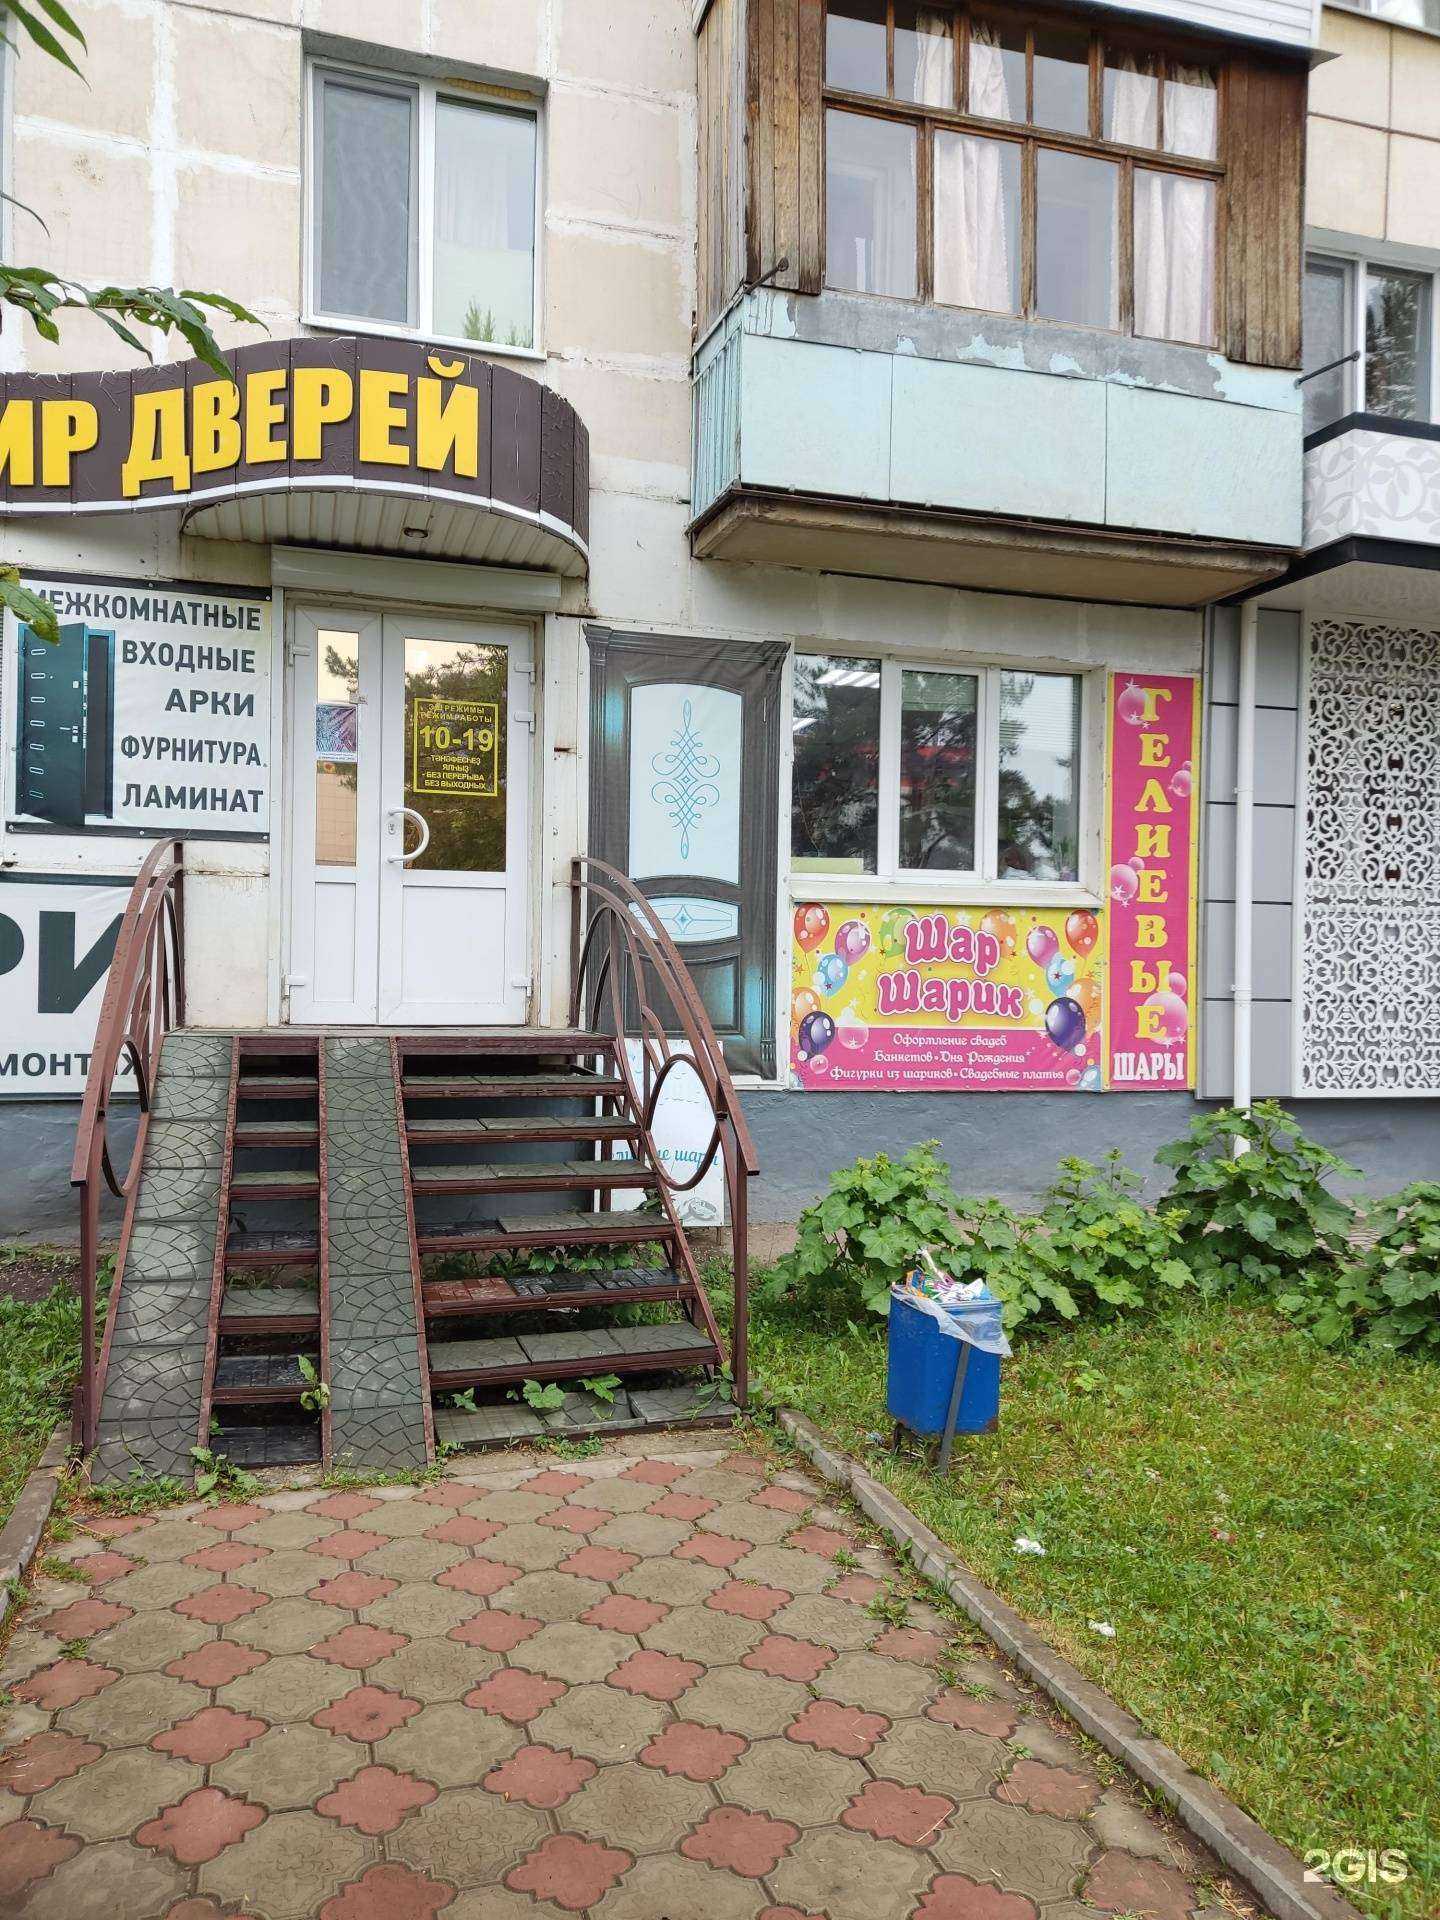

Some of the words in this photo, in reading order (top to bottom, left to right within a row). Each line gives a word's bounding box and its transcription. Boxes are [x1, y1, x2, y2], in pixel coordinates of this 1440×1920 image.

[122, 355, 480, 498] ДВЕРЕЙ
[28, 588, 261, 632] ЕЖКОМНАТНЫЕ
[122, 639, 256, 674] ВХОДНЫЕ
[164, 687, 254, 717] АРКИ
[445, 705, 485, 714] РЕЖИМЫ
[421, 711, 453, 720] РЕЖИМ
[454, 714, 493, 723] РАБОТЫ
[120, 735, 261, 766] ФУРНИТУРА
[419, 725, 494, 752] 10-19
[424, 779, 440, 787] БЕЗ
[440, 781, 487, 790] ВЫХОДНЫХ
[442, 772, 485, 781] ПЕРЕРЫВА
[122, 783, 264, 813] ЛАМИНАТ
[904, 914, 1000, 977] Шар
[877, 970, 1024, 1022] Шарик
[893, 1033, 967, 1047] Оформление
[970, 1034, 1008, 1048] свадеб
[829, 1065, 883, 1080] Фигурки
[887, 1069, 900, 1080] из
[1022, 1071, 1064, 1080] платья
[967, 1051, 1025, 1065] Рождения
[1112, 1052, 1185, 1081] ШАРЫ
